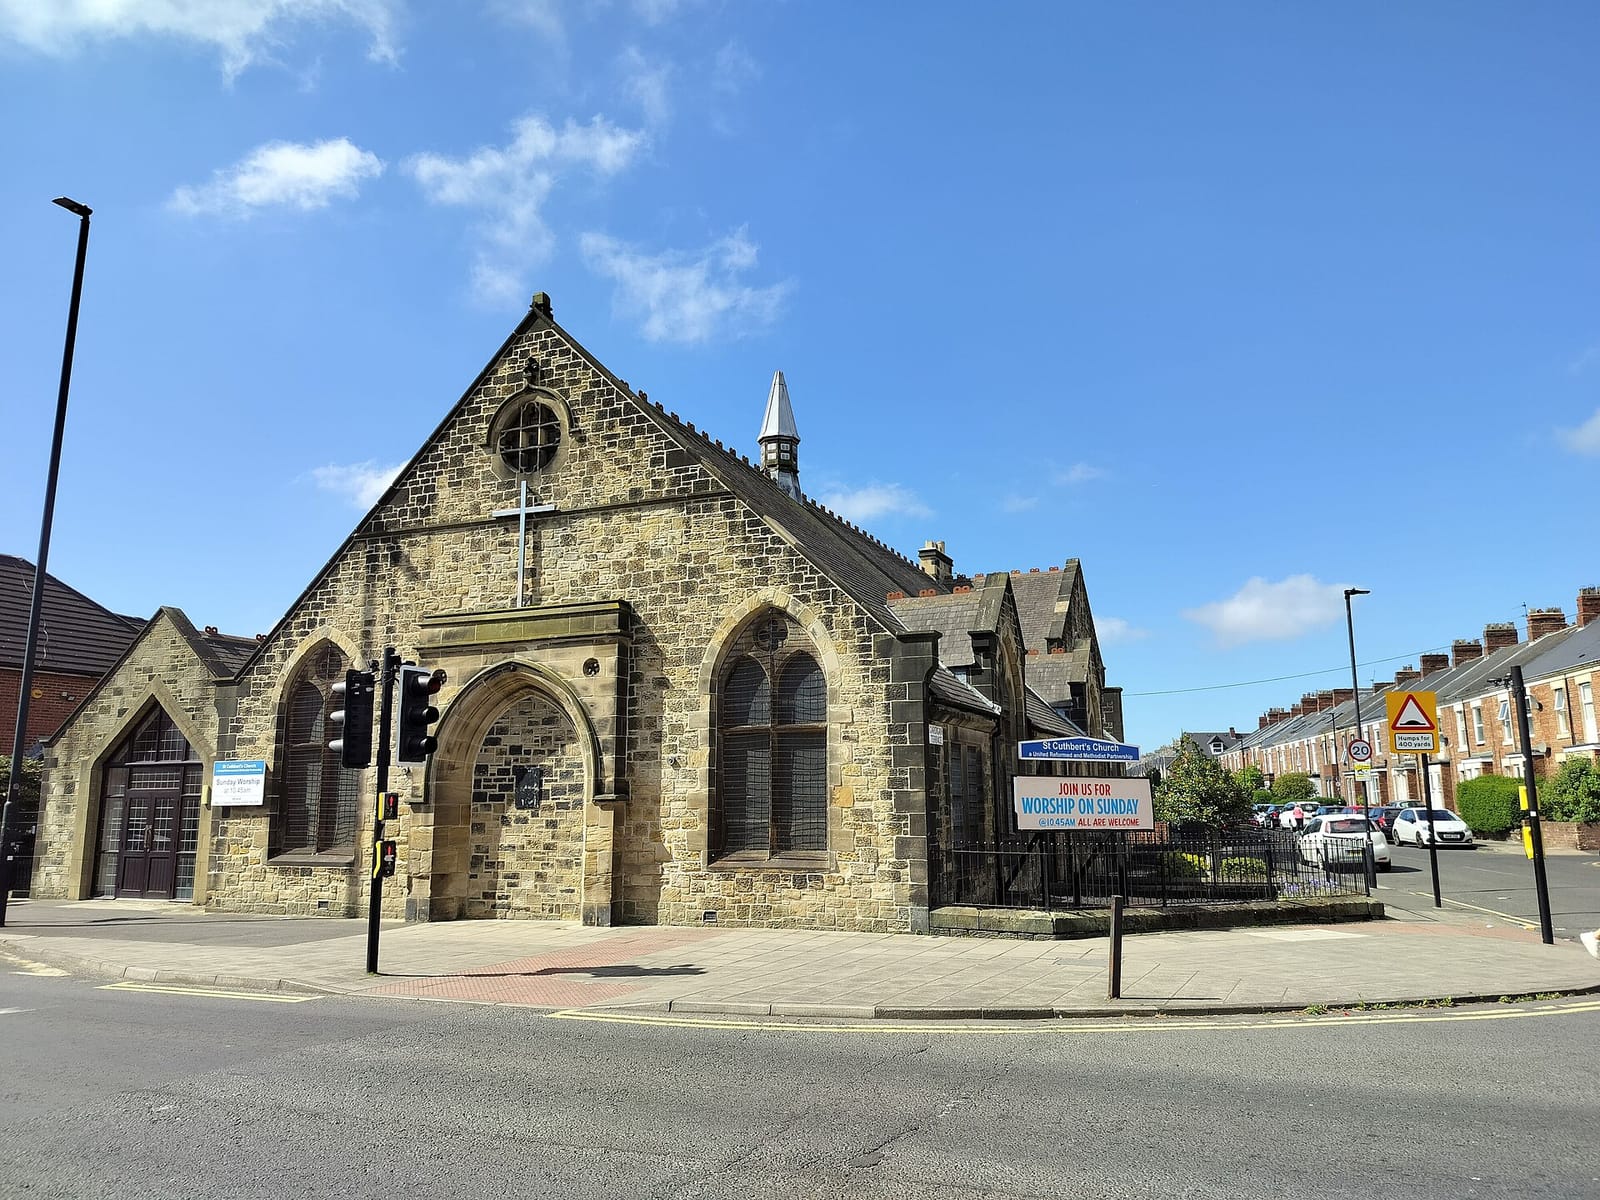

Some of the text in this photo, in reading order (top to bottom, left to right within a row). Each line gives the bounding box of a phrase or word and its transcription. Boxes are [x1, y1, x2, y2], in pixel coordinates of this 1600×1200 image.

[1042, 741, 1120, 752] St Cuthbert's Church
[1352, 745, 1369, 755] 20
[216, 778, 261, 786] Sunday Worship
[1059, 783, 1111, 796] JOIN US FOR
[1021, 797, 1139, 815] WORSHIP ON SUNDAY
[1078, 818, 1091, 826] ALL
[1093, 818, 1106, 826] ARE
[1108, 818, 1139, 827] WELCOME
